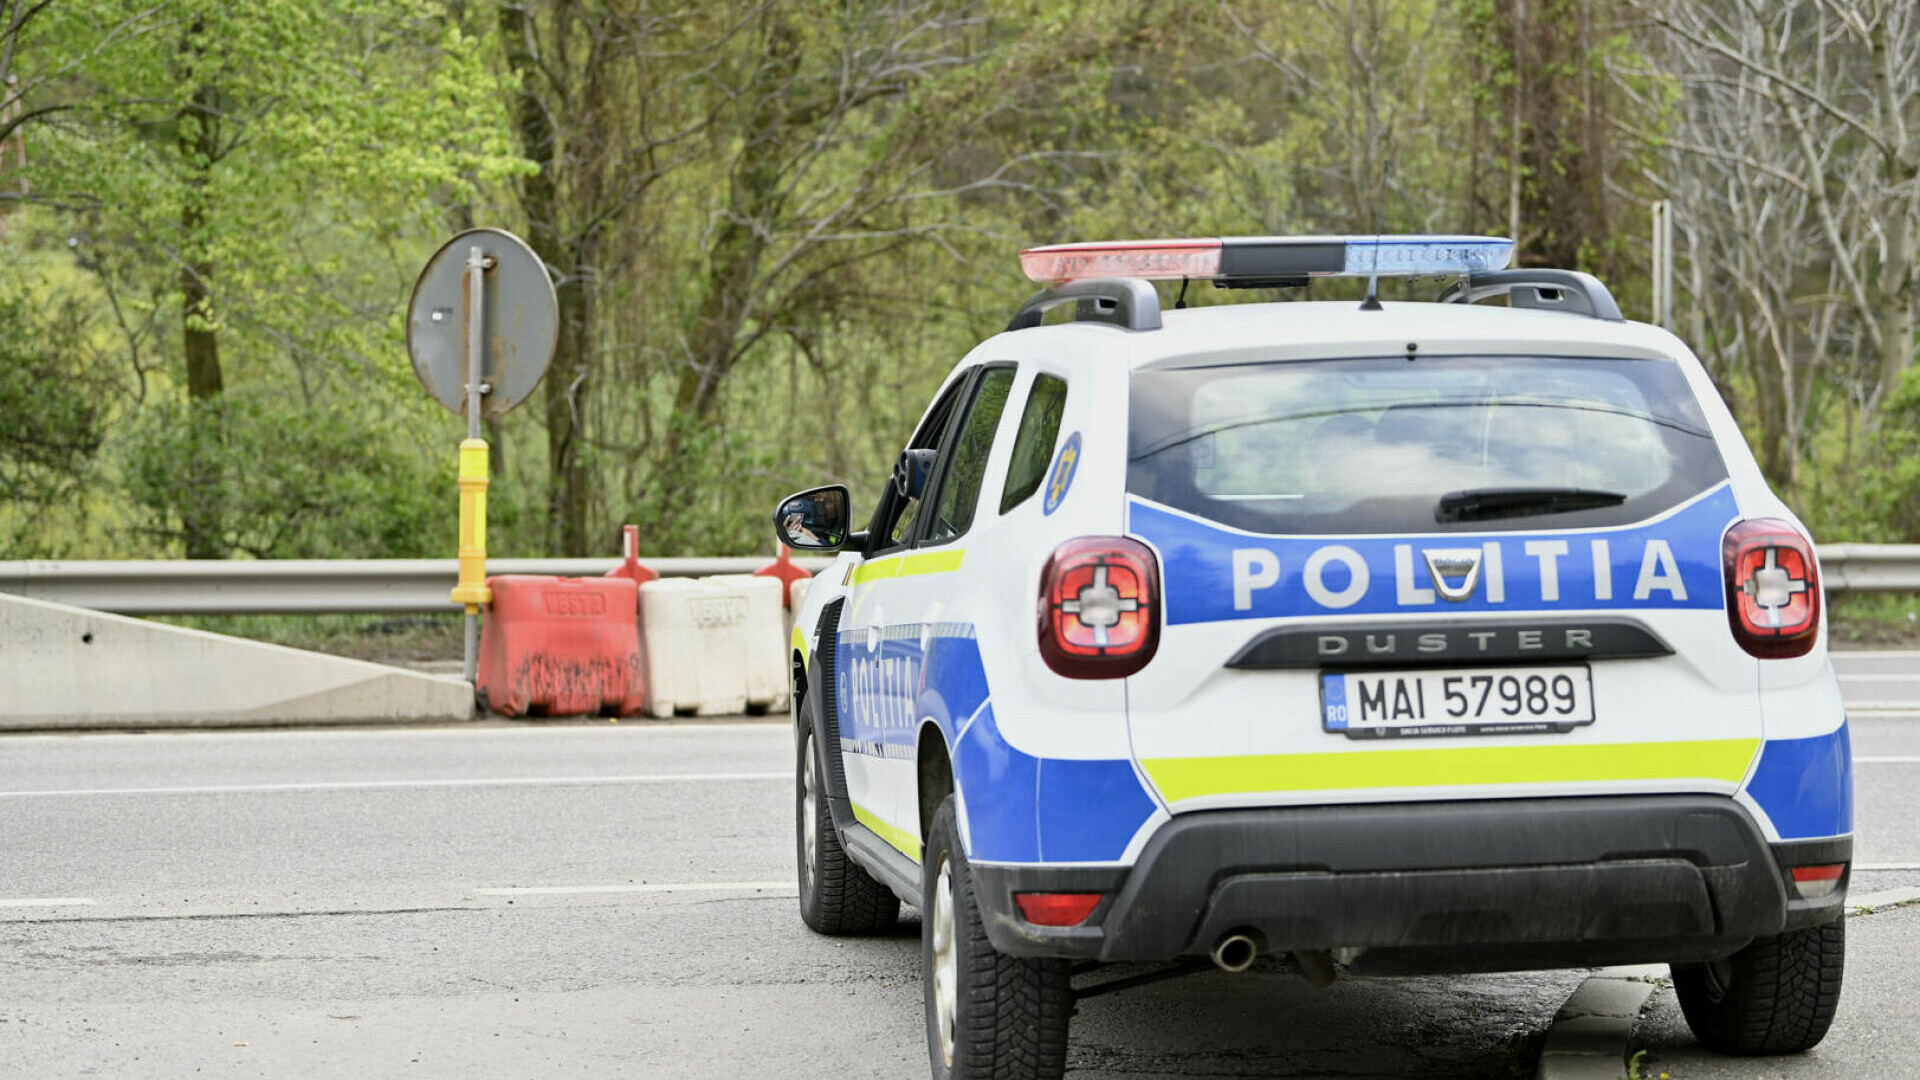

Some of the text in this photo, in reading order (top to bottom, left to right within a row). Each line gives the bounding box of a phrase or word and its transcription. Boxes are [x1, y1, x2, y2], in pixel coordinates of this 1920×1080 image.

[1232, 540, 1689, 611] POLITIA
[1318, 629, 1593, 655] DUSTER
[852, 655, 916, 729] POLITIA
[1327, 705, 1347, 722] RO
[1358, 674, 1576, 720] MAI 57989
